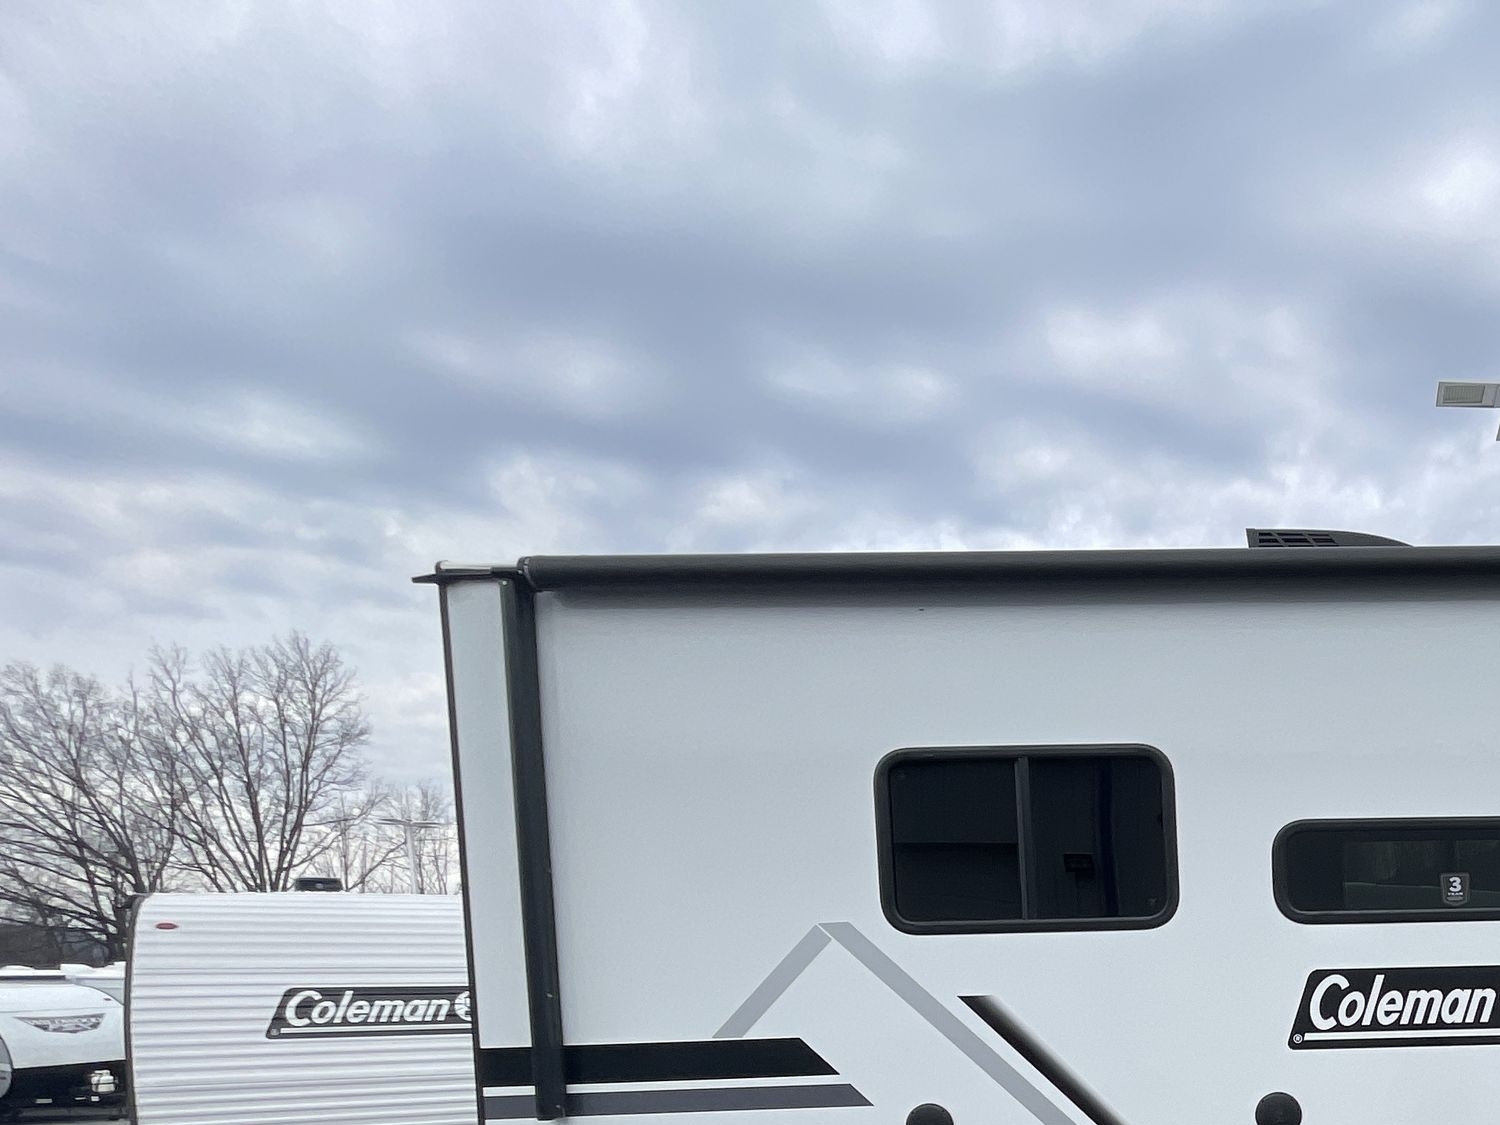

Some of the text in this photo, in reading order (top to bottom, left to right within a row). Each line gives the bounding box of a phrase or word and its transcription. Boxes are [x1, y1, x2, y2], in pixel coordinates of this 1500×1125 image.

[1449, 876, 1462, 892] 3
[285, 990, 450, 1027] Coleman
[1309, 973, 1497, 1031] Coleman
